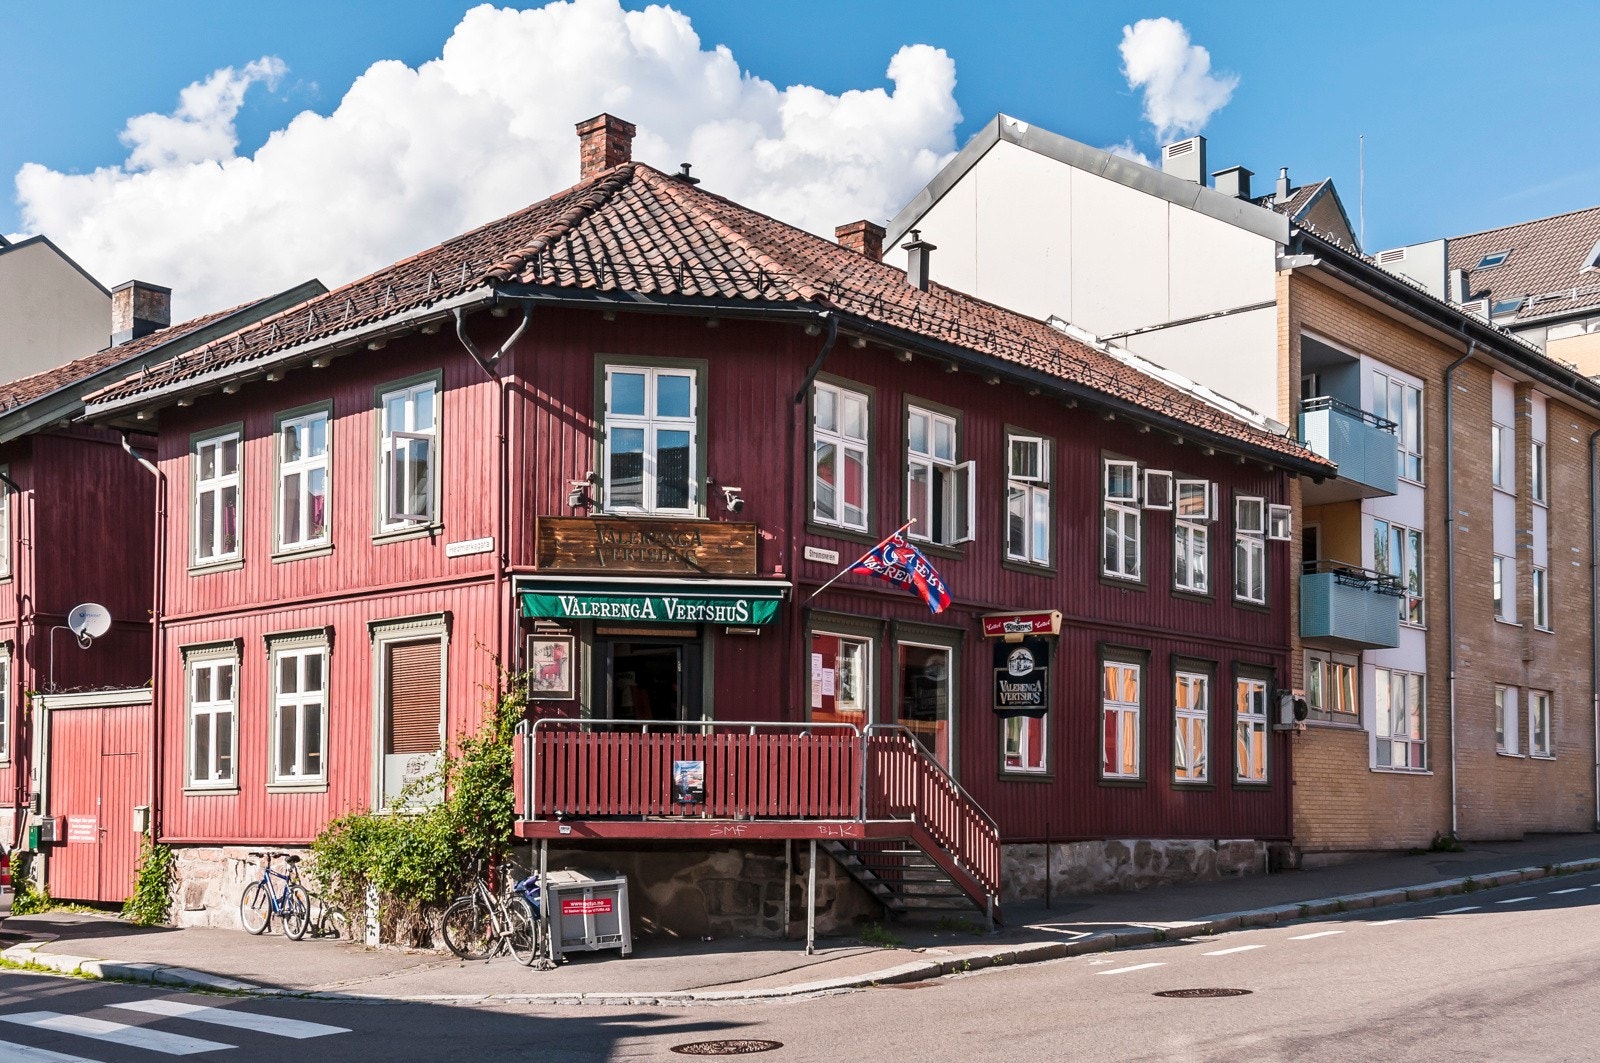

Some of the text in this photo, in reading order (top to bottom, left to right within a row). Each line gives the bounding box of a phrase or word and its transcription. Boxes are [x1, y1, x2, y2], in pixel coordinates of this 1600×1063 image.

[558, 595, 749, 622] VÅLERENGA VERTSHUS
[1005, 622, 1032, 631] Ringnes
[1000, 691, 1041, 705] VERTSHUS
[818, 825, 857, 837] BLK
